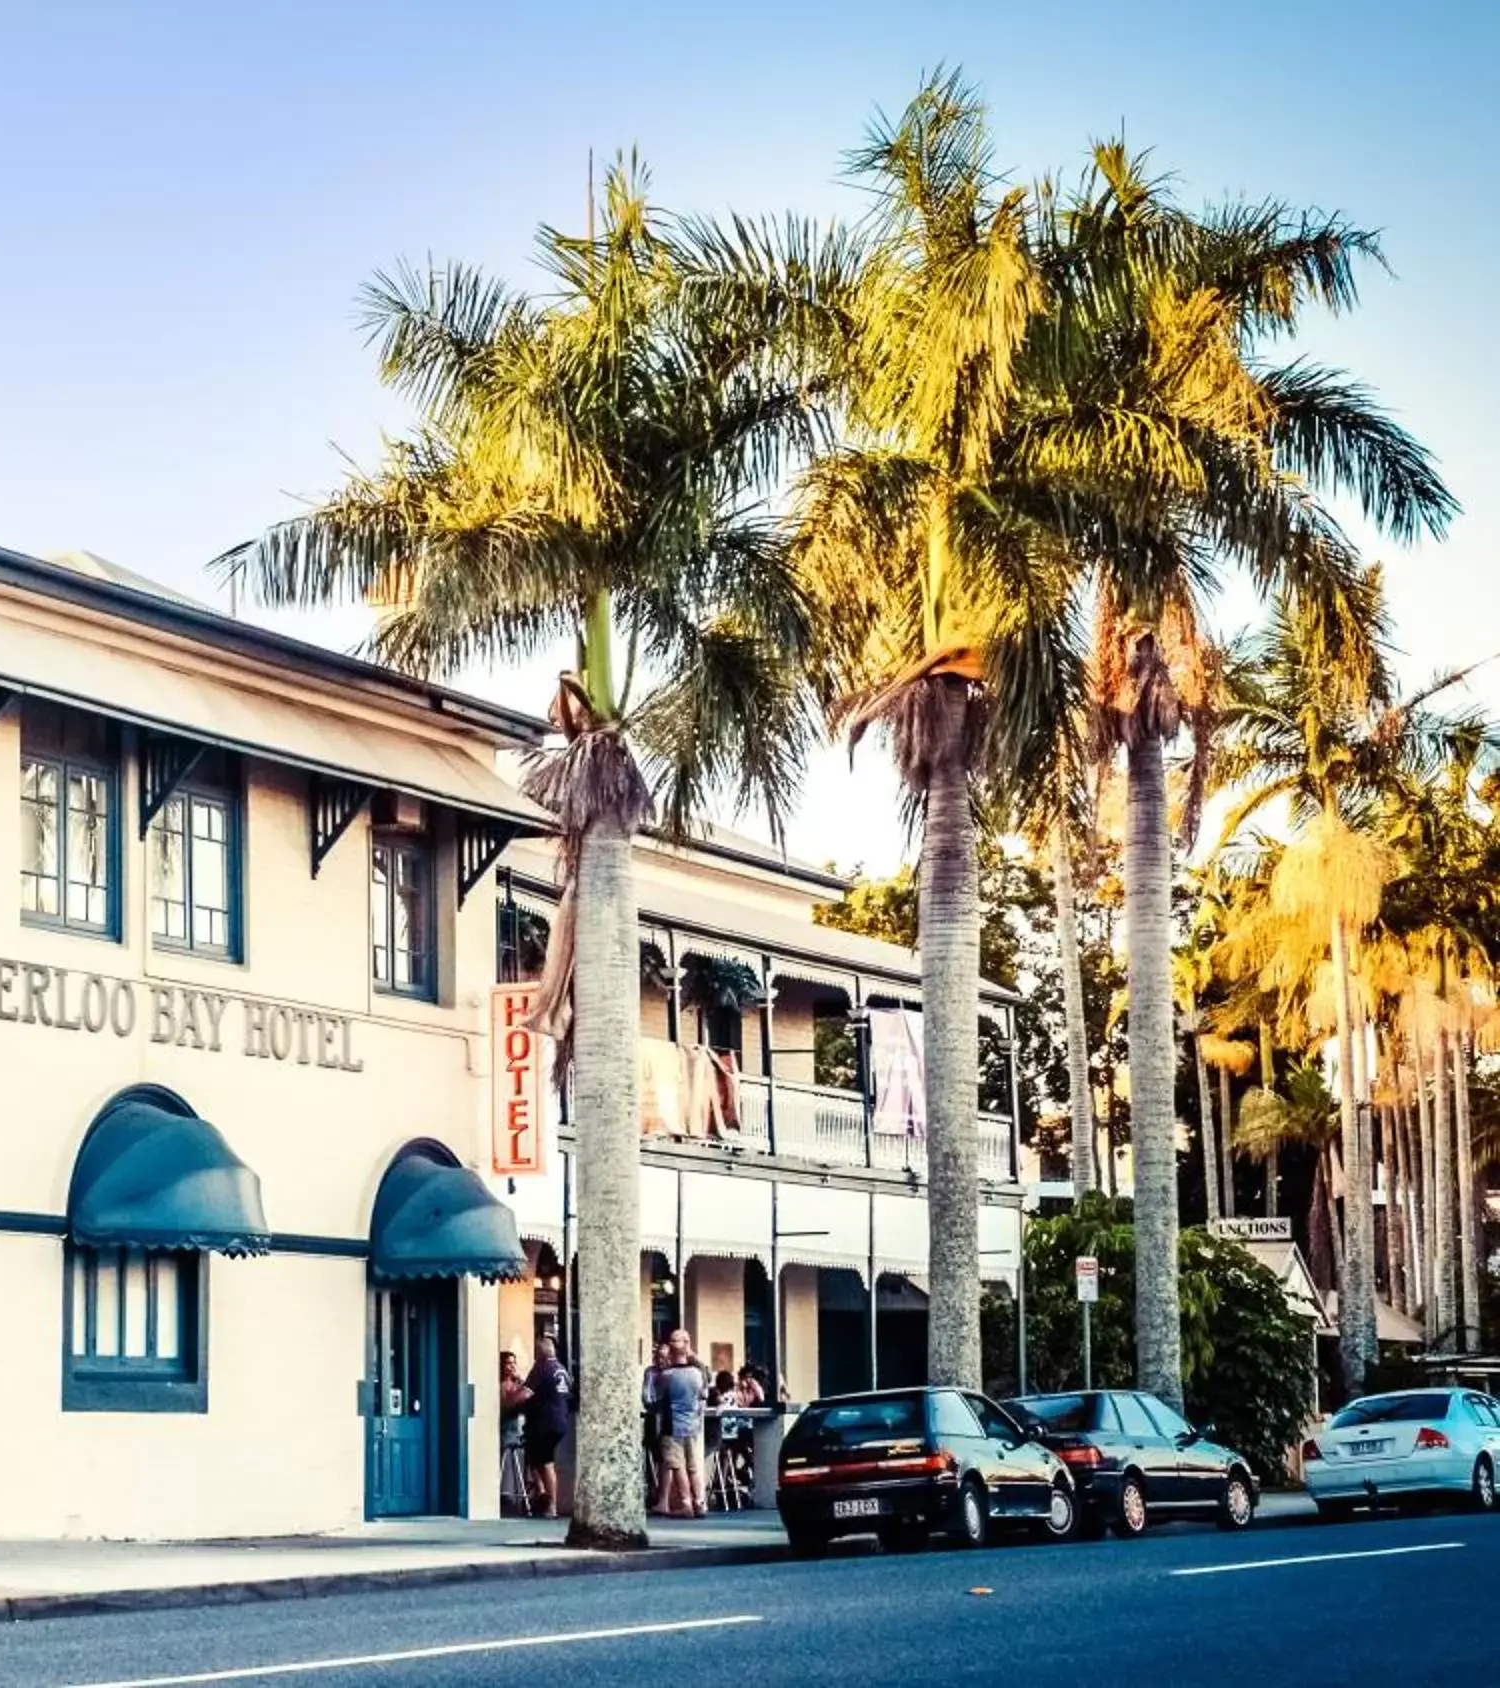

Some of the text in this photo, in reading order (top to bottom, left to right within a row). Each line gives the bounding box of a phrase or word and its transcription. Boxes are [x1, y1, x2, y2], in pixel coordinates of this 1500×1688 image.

[148, 984, 228, 1052] BAY
[243, 998, 364, 1073] HOTEL
[504, 996, 532, 1165] HOTEL
[1219, 1222, 1287, 1235] UNCTIONS
